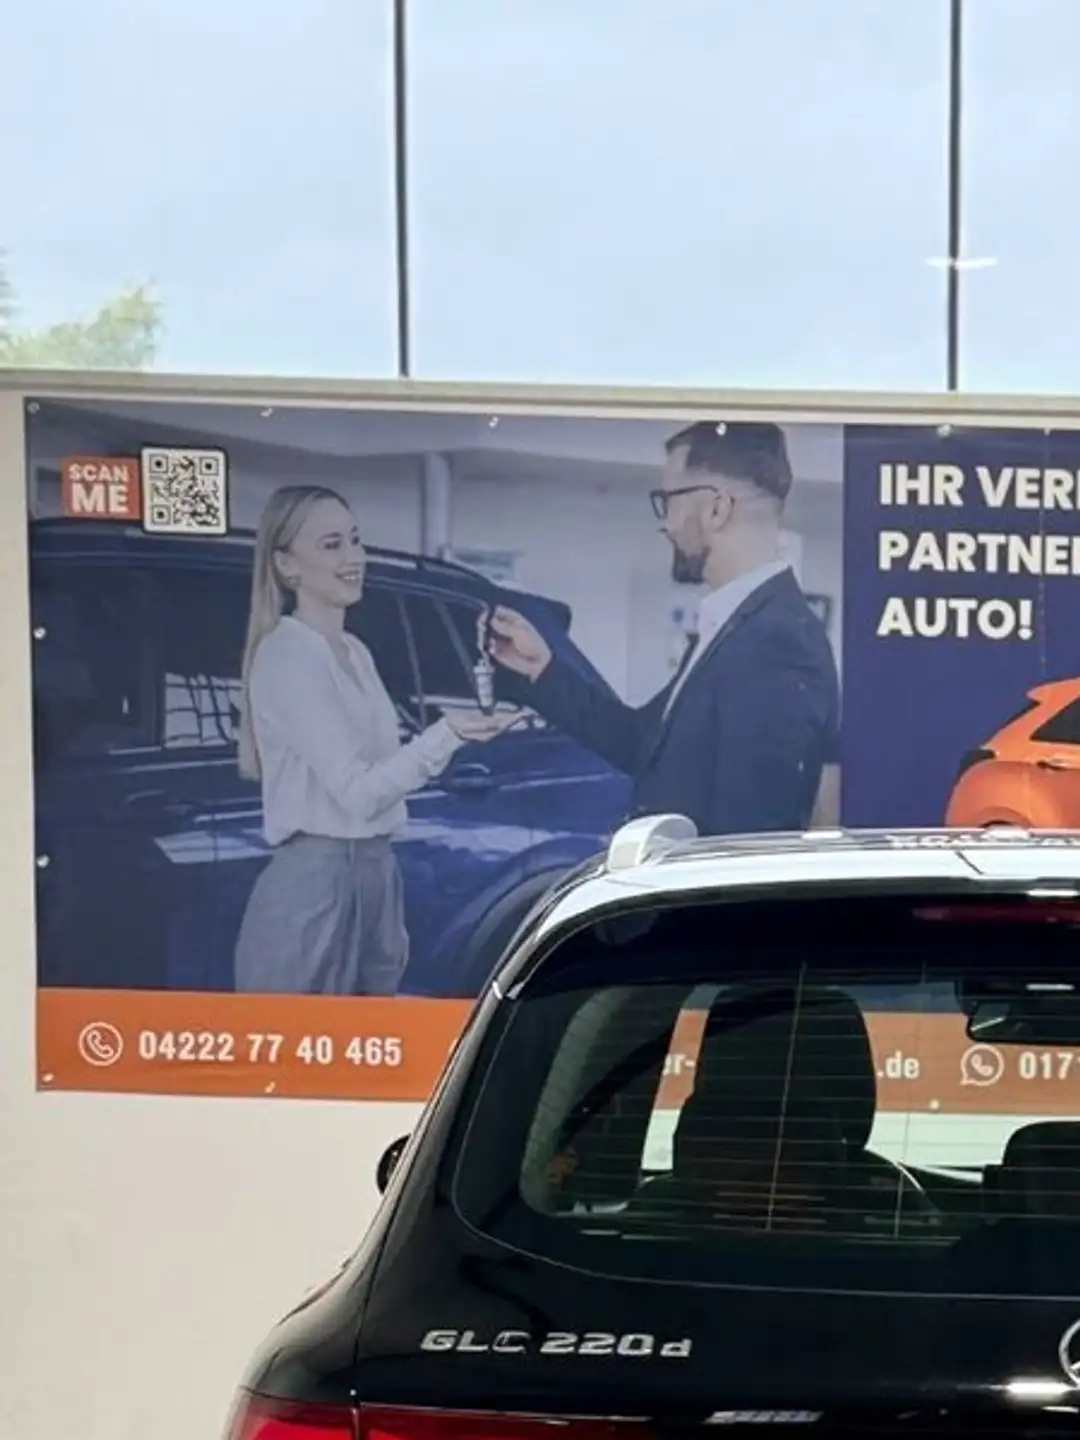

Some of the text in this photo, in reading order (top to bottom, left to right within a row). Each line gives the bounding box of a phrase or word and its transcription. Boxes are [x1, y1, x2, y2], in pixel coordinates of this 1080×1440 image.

[68, 463, 129, 481] SCAN
[878, 464, 965, 506] IHR
[72, 482, 129, 513] ME
[876, 597, 1033, 640] AUTO!
[138, 1031, 402, 1067] 04222 77 40 465
[420, 1330, 532, 1354] GLC
